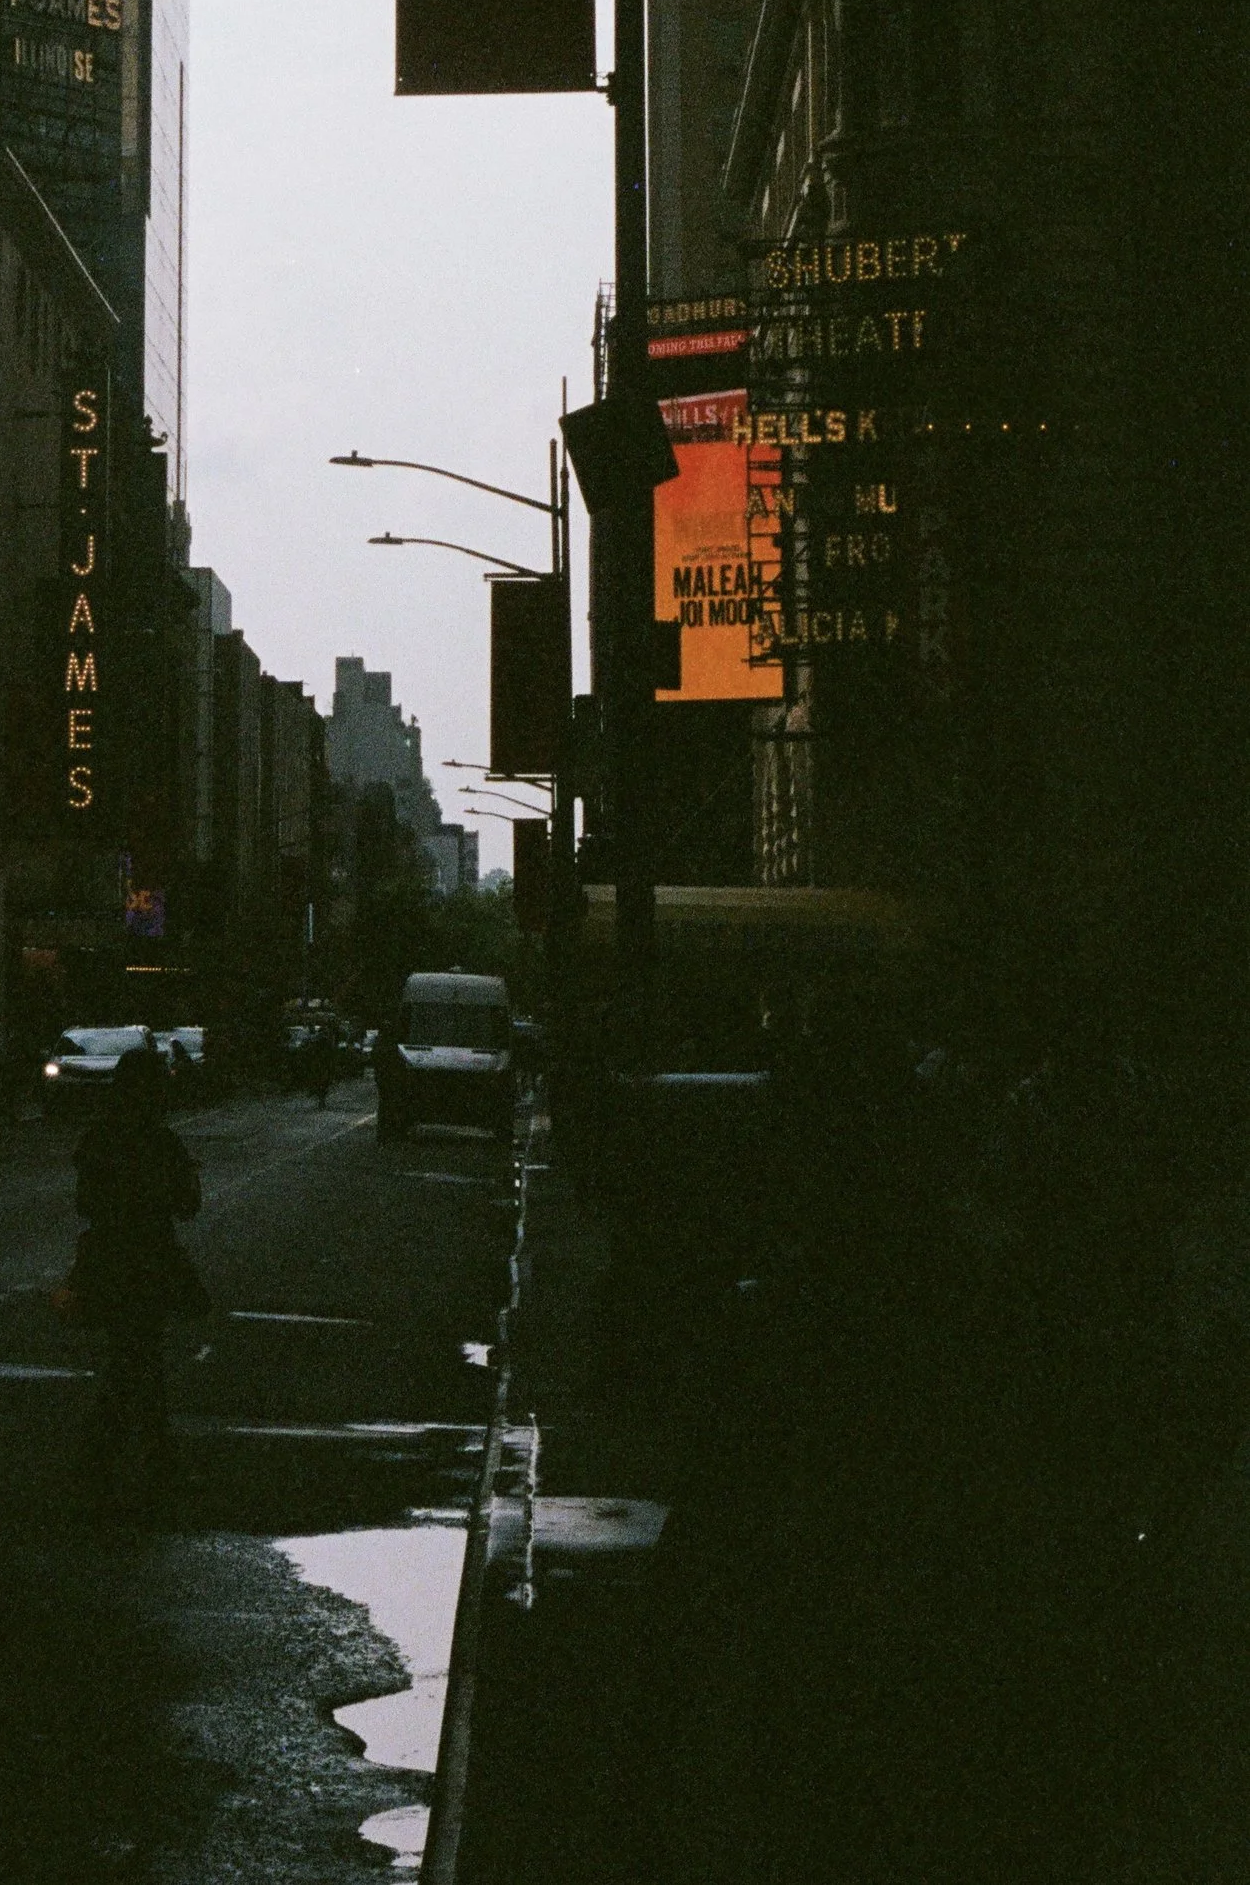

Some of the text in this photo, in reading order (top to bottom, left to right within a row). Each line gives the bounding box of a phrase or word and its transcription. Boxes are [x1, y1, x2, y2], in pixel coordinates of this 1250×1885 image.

[766, 232, 968, 289] SHUBERT
[731, 408, 847, 446] HELL'S
[673, 563, 763, 598] MALEAH
[65, 534, 98, 809] JAMES
